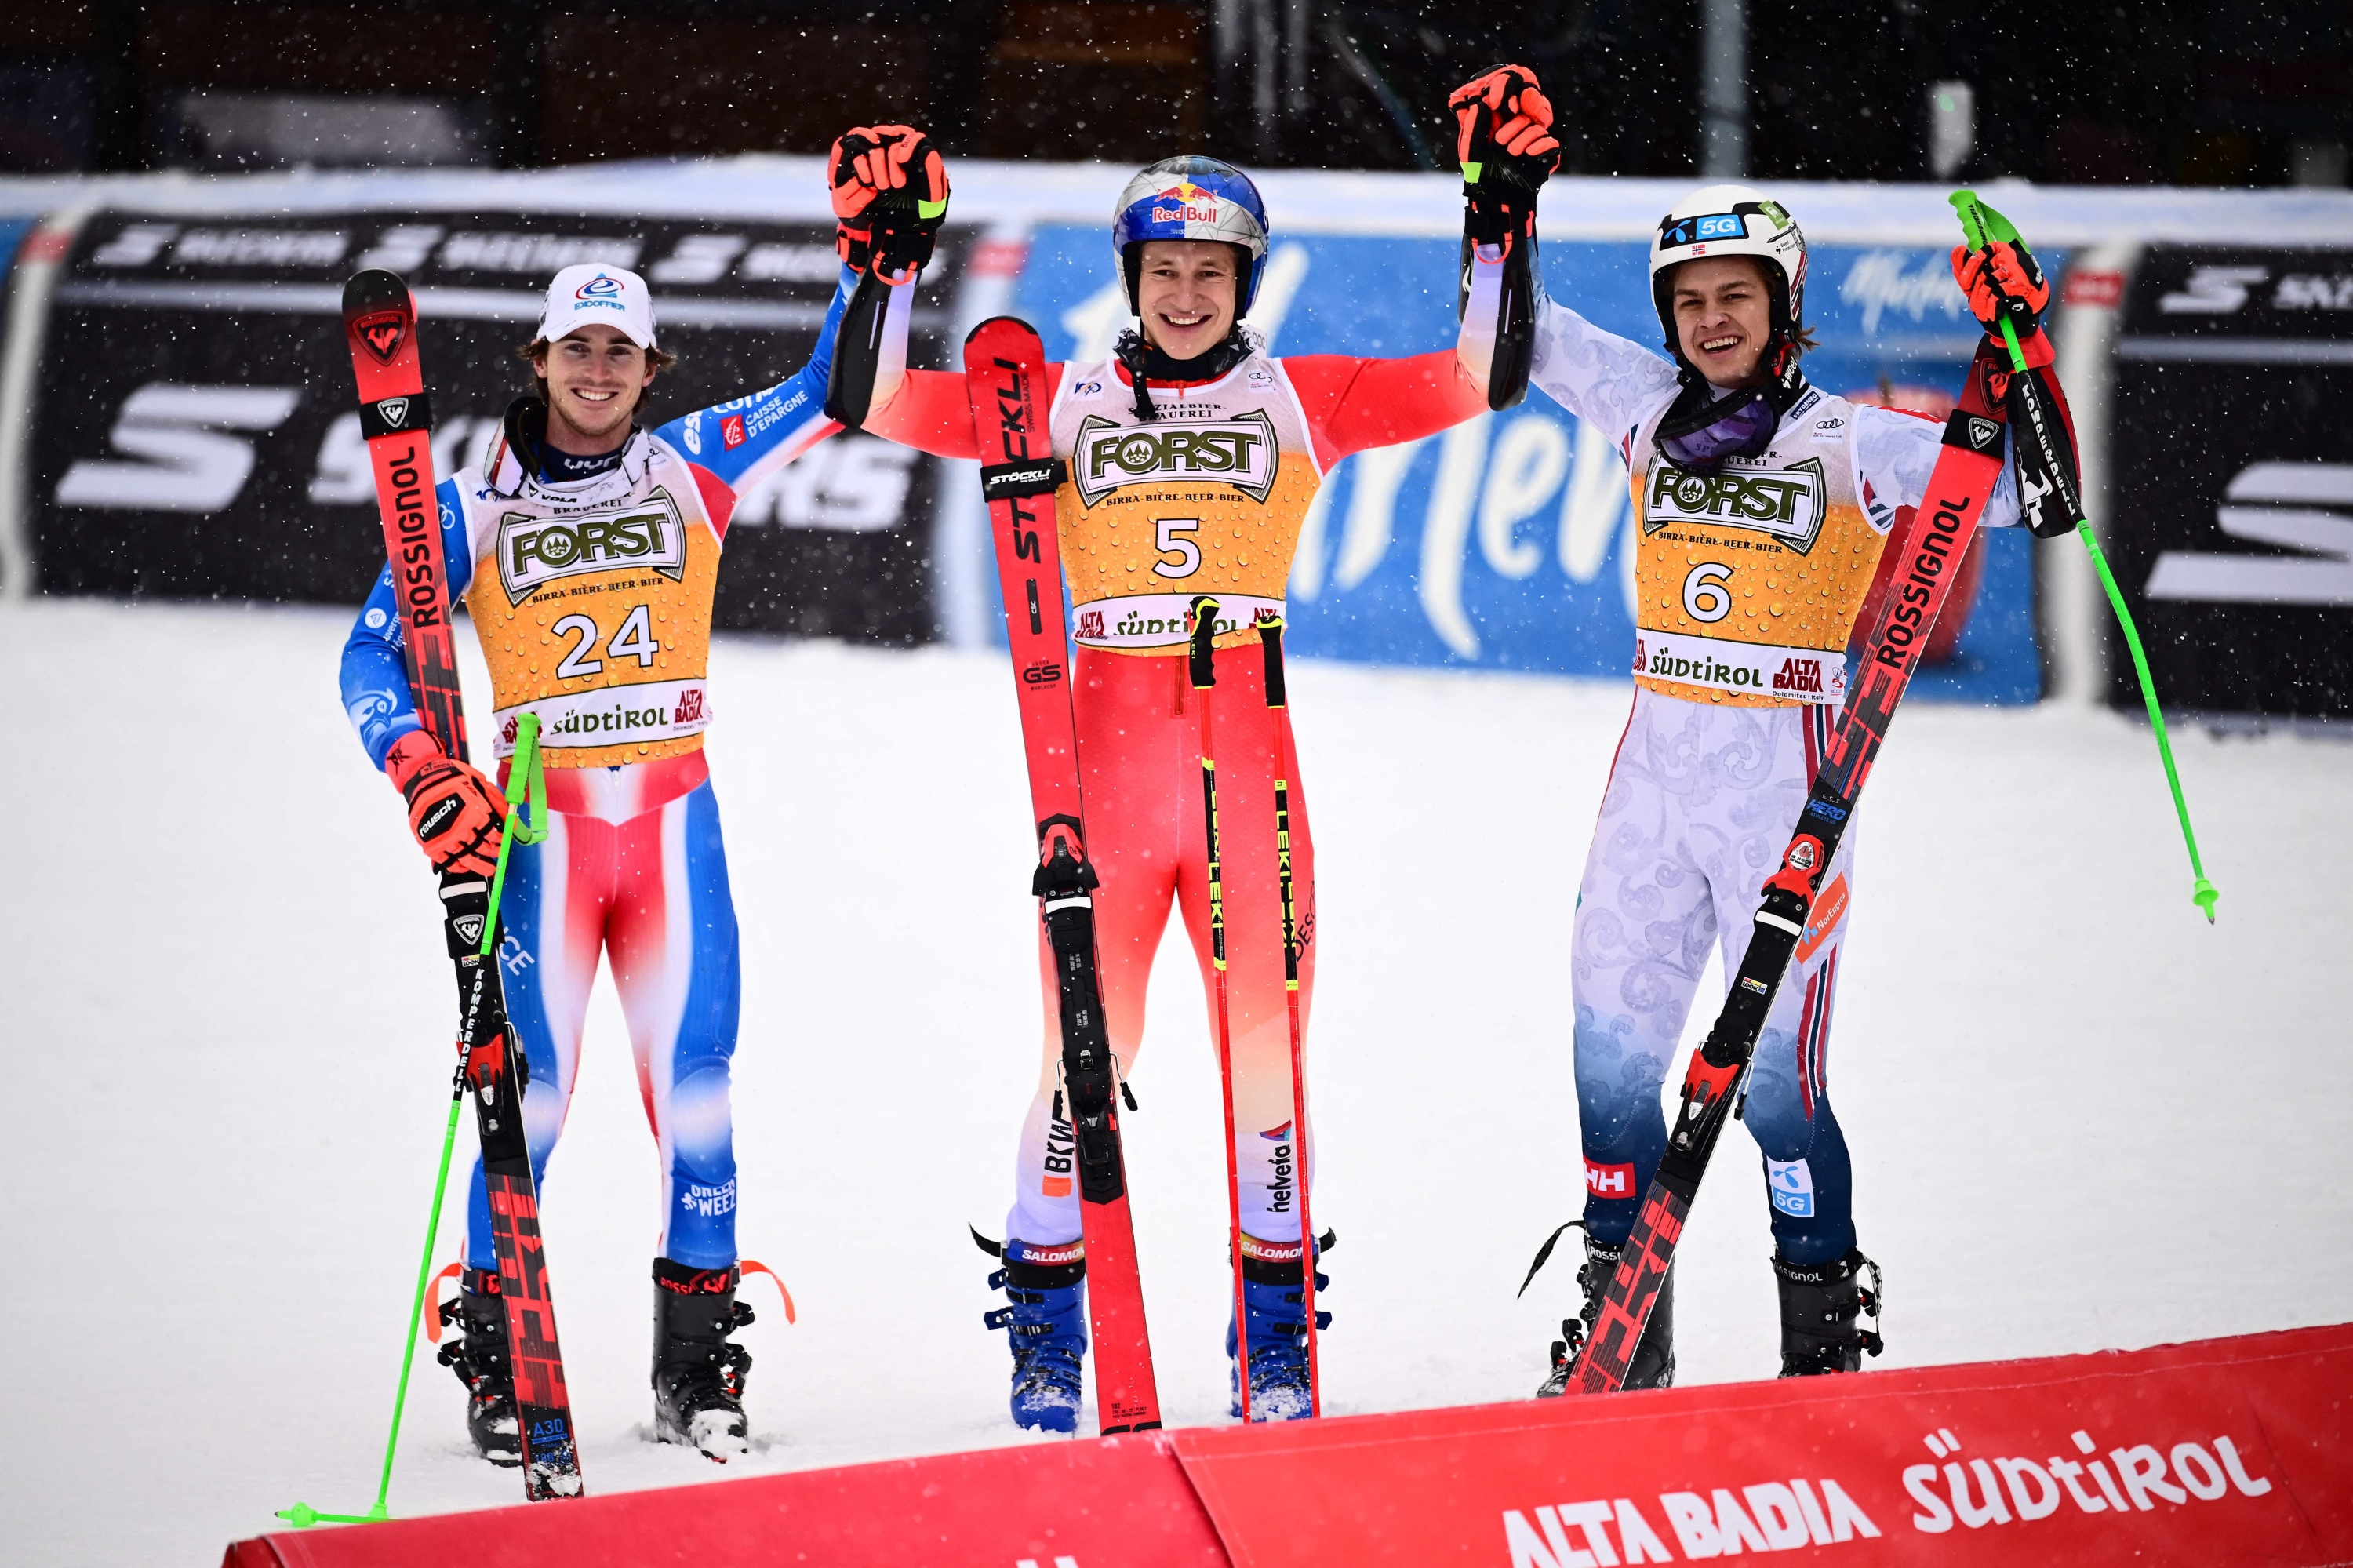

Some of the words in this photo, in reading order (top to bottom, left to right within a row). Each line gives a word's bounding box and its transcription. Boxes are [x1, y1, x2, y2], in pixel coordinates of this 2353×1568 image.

[1152, 205, 1184, 223] Red
[1187, 206, 1217, 223] Bull
[1700, 218, 1737, 235] 5G
[1968, 204, 1988, 246] OMPERDELL
[574, 300, 625, 312] EXCOFFIER
[1020, 371, 1030, 402] MADE
[745, 395, 783, 426] CAISSE
[747, 390, 809, 438] D'EPARGNE
[1027, 402, 1036, 433] SWISS
[1973, 420, 1995, 431] ROSSIGNOL
[994, 357, 1041, 564] STCKLI
[1091, 431, 1262, 480] FORST
[2022, 384, 2076, 516] KOMPERDELL
[541, 494, 577, 503] VOLA
[1651, 467, 1811, 525] FORST
[388, 446, 440, 628] ROSSIGNOL
[512, 512, 670, 577] FORST
[1151, 518, 1202, 579] 5
[1682, 562, 1734, 624] 6
[1876, 497, 1970, 670] ROSSIGNOL
[551, 604, 659, 680] 24
[1023, 664, 1061, 684] GS
[1773, 672, 1824, 692] BADIA
[1781, 657, 1821, 676] ALTA
[679, 689, 703, 707] ALTA
[675, 706, 703, 723] BADIA
[420, 799, 456, 837] reusch
[1806, 799, 1846, 820] HERO
[1809, 812, 1829, 823] ATHLETE
[1276, 811, 1291, 876] LEKI
[1209, 862, 1223, 928] LEKI
[1817, 892, 1846, 931] NorEngros
[1742, 980, 1759, 991] LOOK
[455, 968, 485, 1092] KOMPERDELL
[1584, 1169, 1625, 1192] HH
[1775, 1192, 1805, 1212] 5G
[533, 1418, 564, 1437] A30
[1501, 1497, 1674, 1568] ALTA
[1659, 1479, 1882, 1559] BADIA
